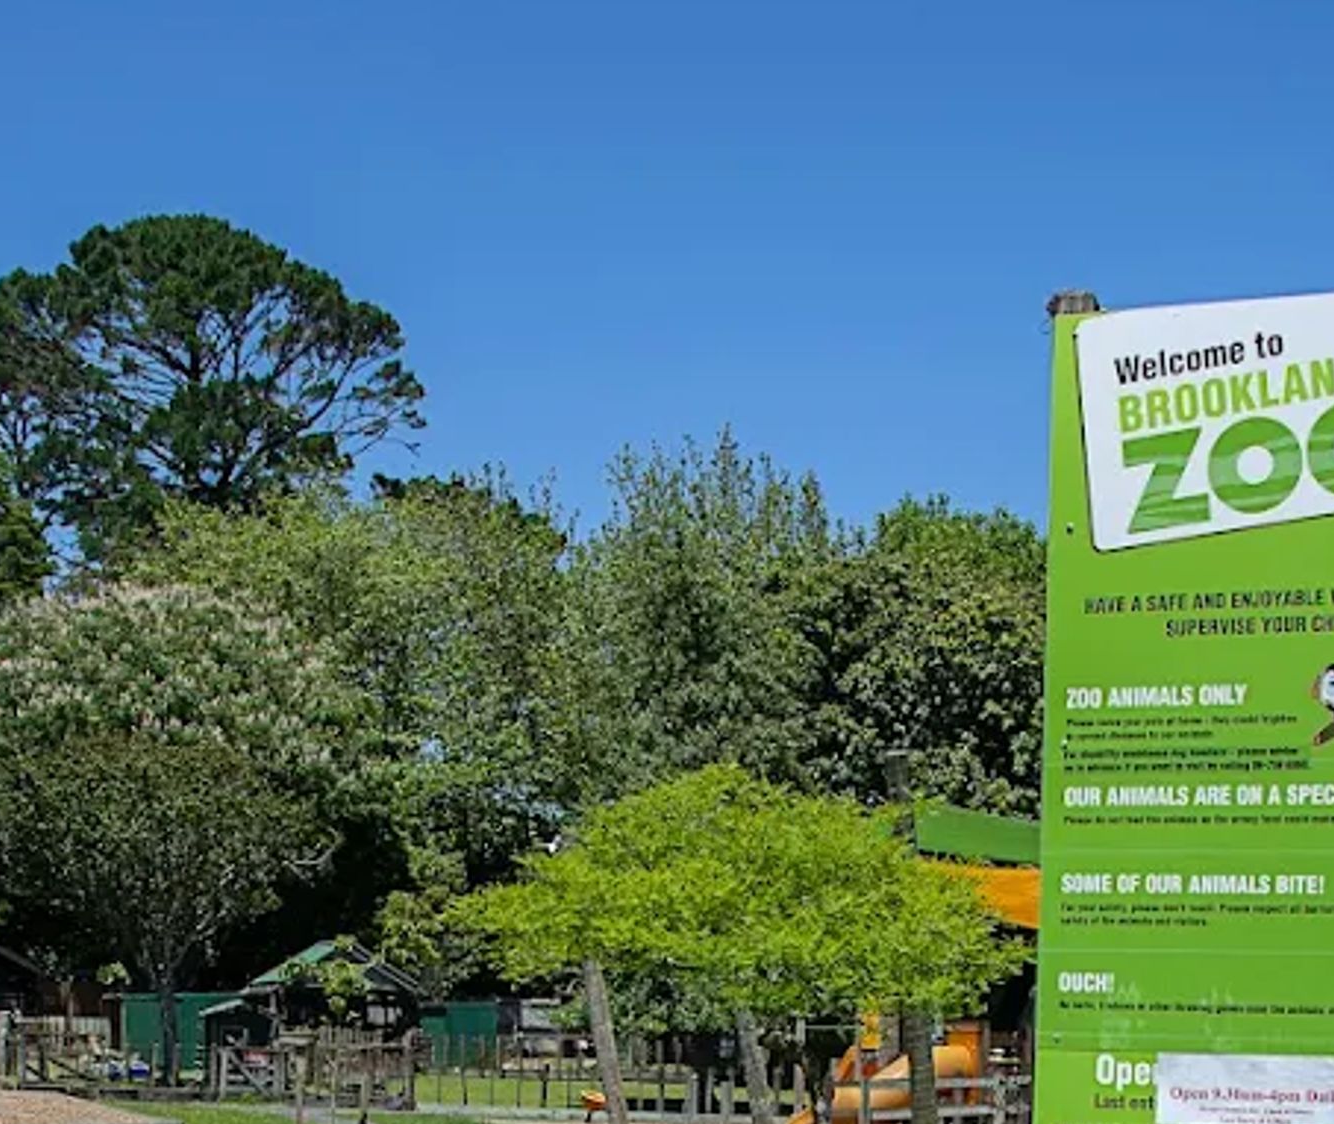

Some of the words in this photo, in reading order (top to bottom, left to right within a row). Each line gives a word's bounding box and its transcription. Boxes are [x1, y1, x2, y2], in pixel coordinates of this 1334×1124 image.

[1114, 338, 1244, 385] Welcome
[1256, 331, 1284, 357] to
[1084, 594, 1126, 614] HAVE
[1131, 594, 1142, 612] A
[1146, 593, 1187, 611] SAFE
[1193, 592, 1225, 610] AND
[1231, 589, 1324, 609] ENJOYABLE
[1166, 617, 1255, 638] SUPERVISE
[1262, 615, 1306, 634] YOUR
[1066, 687, 1103, 709] ZOO
[1107, 685, 1194, 708] ANIMALS
[1199, 683, 1248, 706] ONLY
[1063, 786, 1102, 806] OUR
[1107, 785, 1189, 806] ANIMALS
[1193, 785, 1231, 806] ARE
[1237, 784, 1262, 805] ON
[1268, 784, 1281, 805] A
[1060, 873, 1113, 894] SOME
[1117, 874, 1141, 894] OF
[1146, 874, 1182, 894] OUR
[1188, 874, 1271, 894] ANIMALS
[1275, 874, 1325, 894] BITE!
[1058, 971, 1114, 993] OUCH!
[1096, 1053, 1157, 1092] Ope
[1094, 1093, 1125, 1110] Last
[1169, 1086, 1208, 1103] Open
